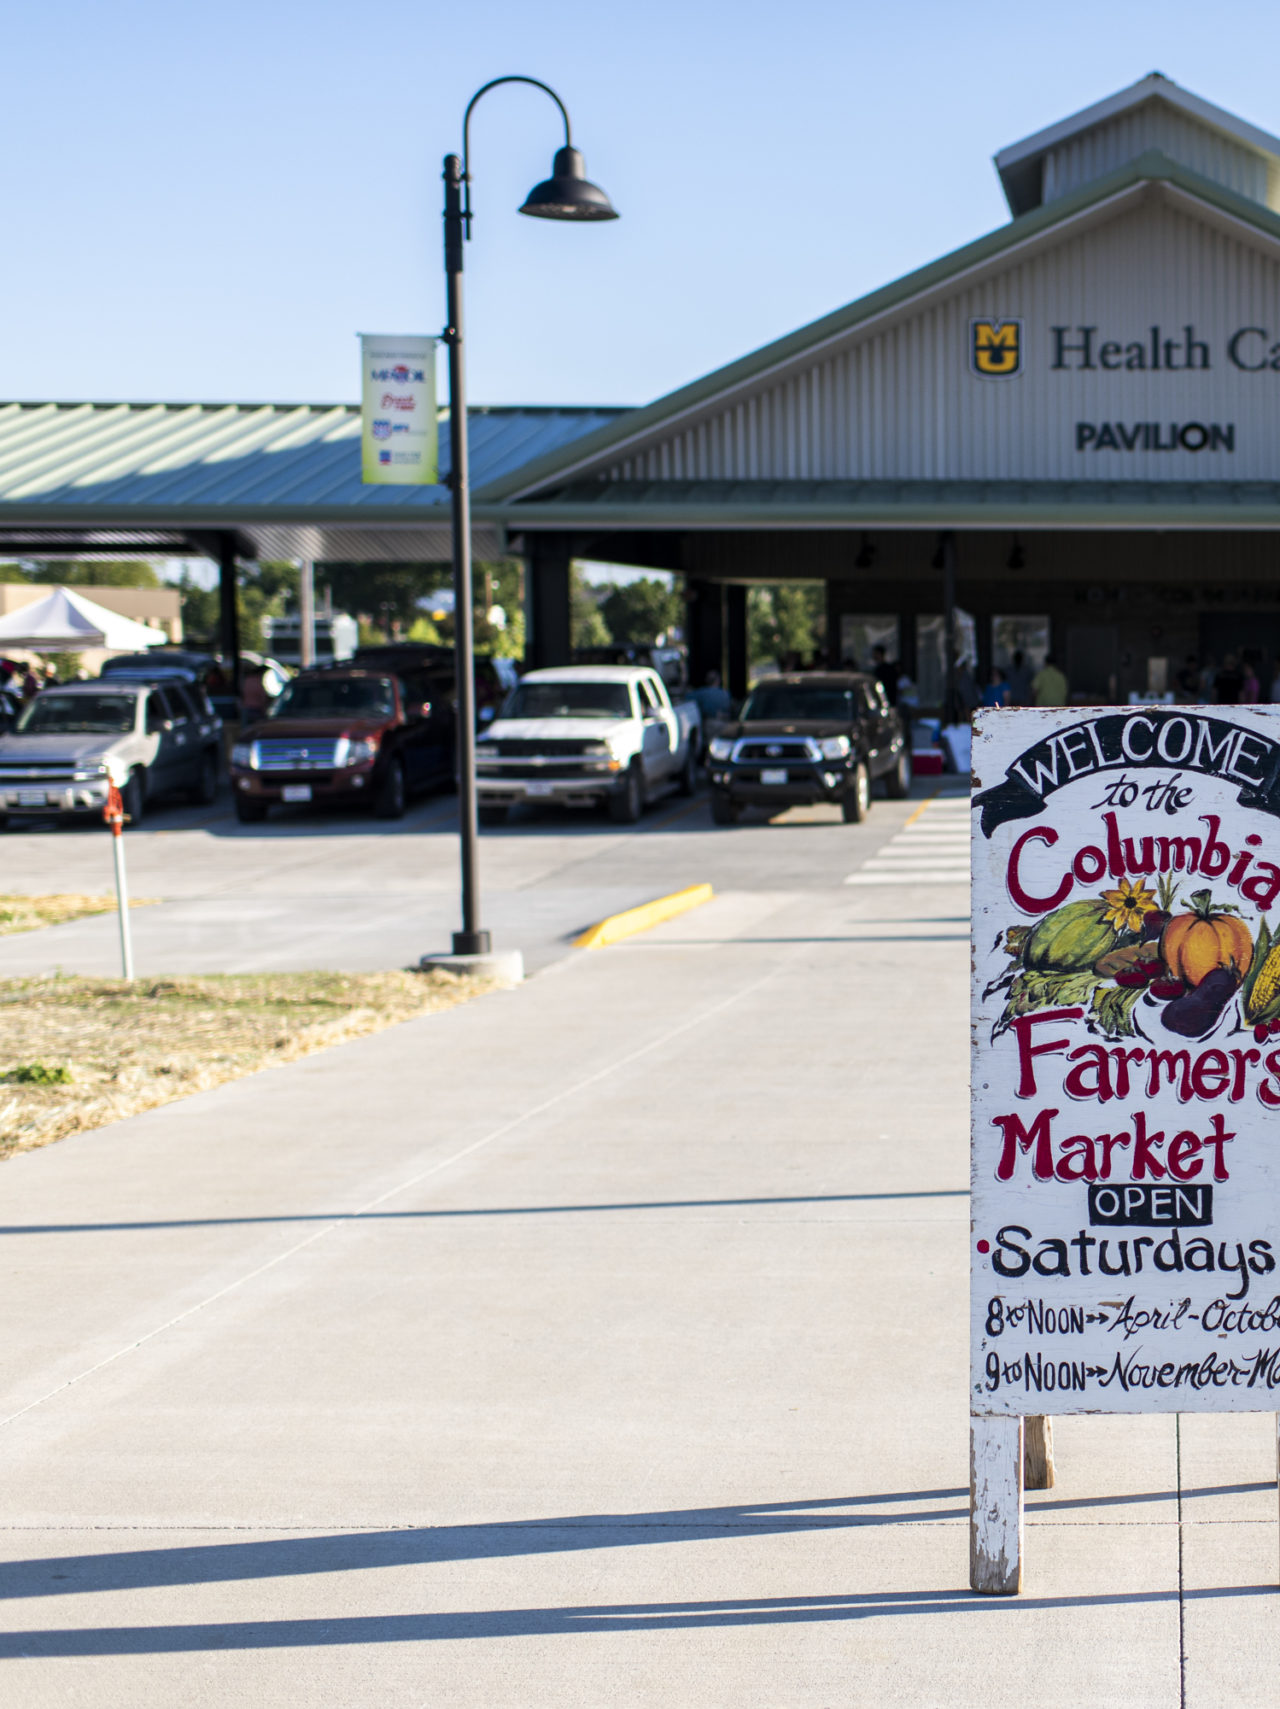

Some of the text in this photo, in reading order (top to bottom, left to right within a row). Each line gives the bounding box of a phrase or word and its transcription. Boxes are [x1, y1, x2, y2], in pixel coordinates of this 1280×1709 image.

[1050, 325, 1211, 371] Health
[1075, 422, 1236, 453] PAVILION
[1011, 715, 1273, 795] WELCOME
[1090, 772, 1195, 815] to the
[990, 1108, 1237, 1183] Market
[1094, 1187, 1204, 1220] OPEN
[991, 1225, 1276, 1300] Saturdays
[1027, 1299, 1084, 1335] NOON
[1024, 1352, 1086, 1392] NOON
